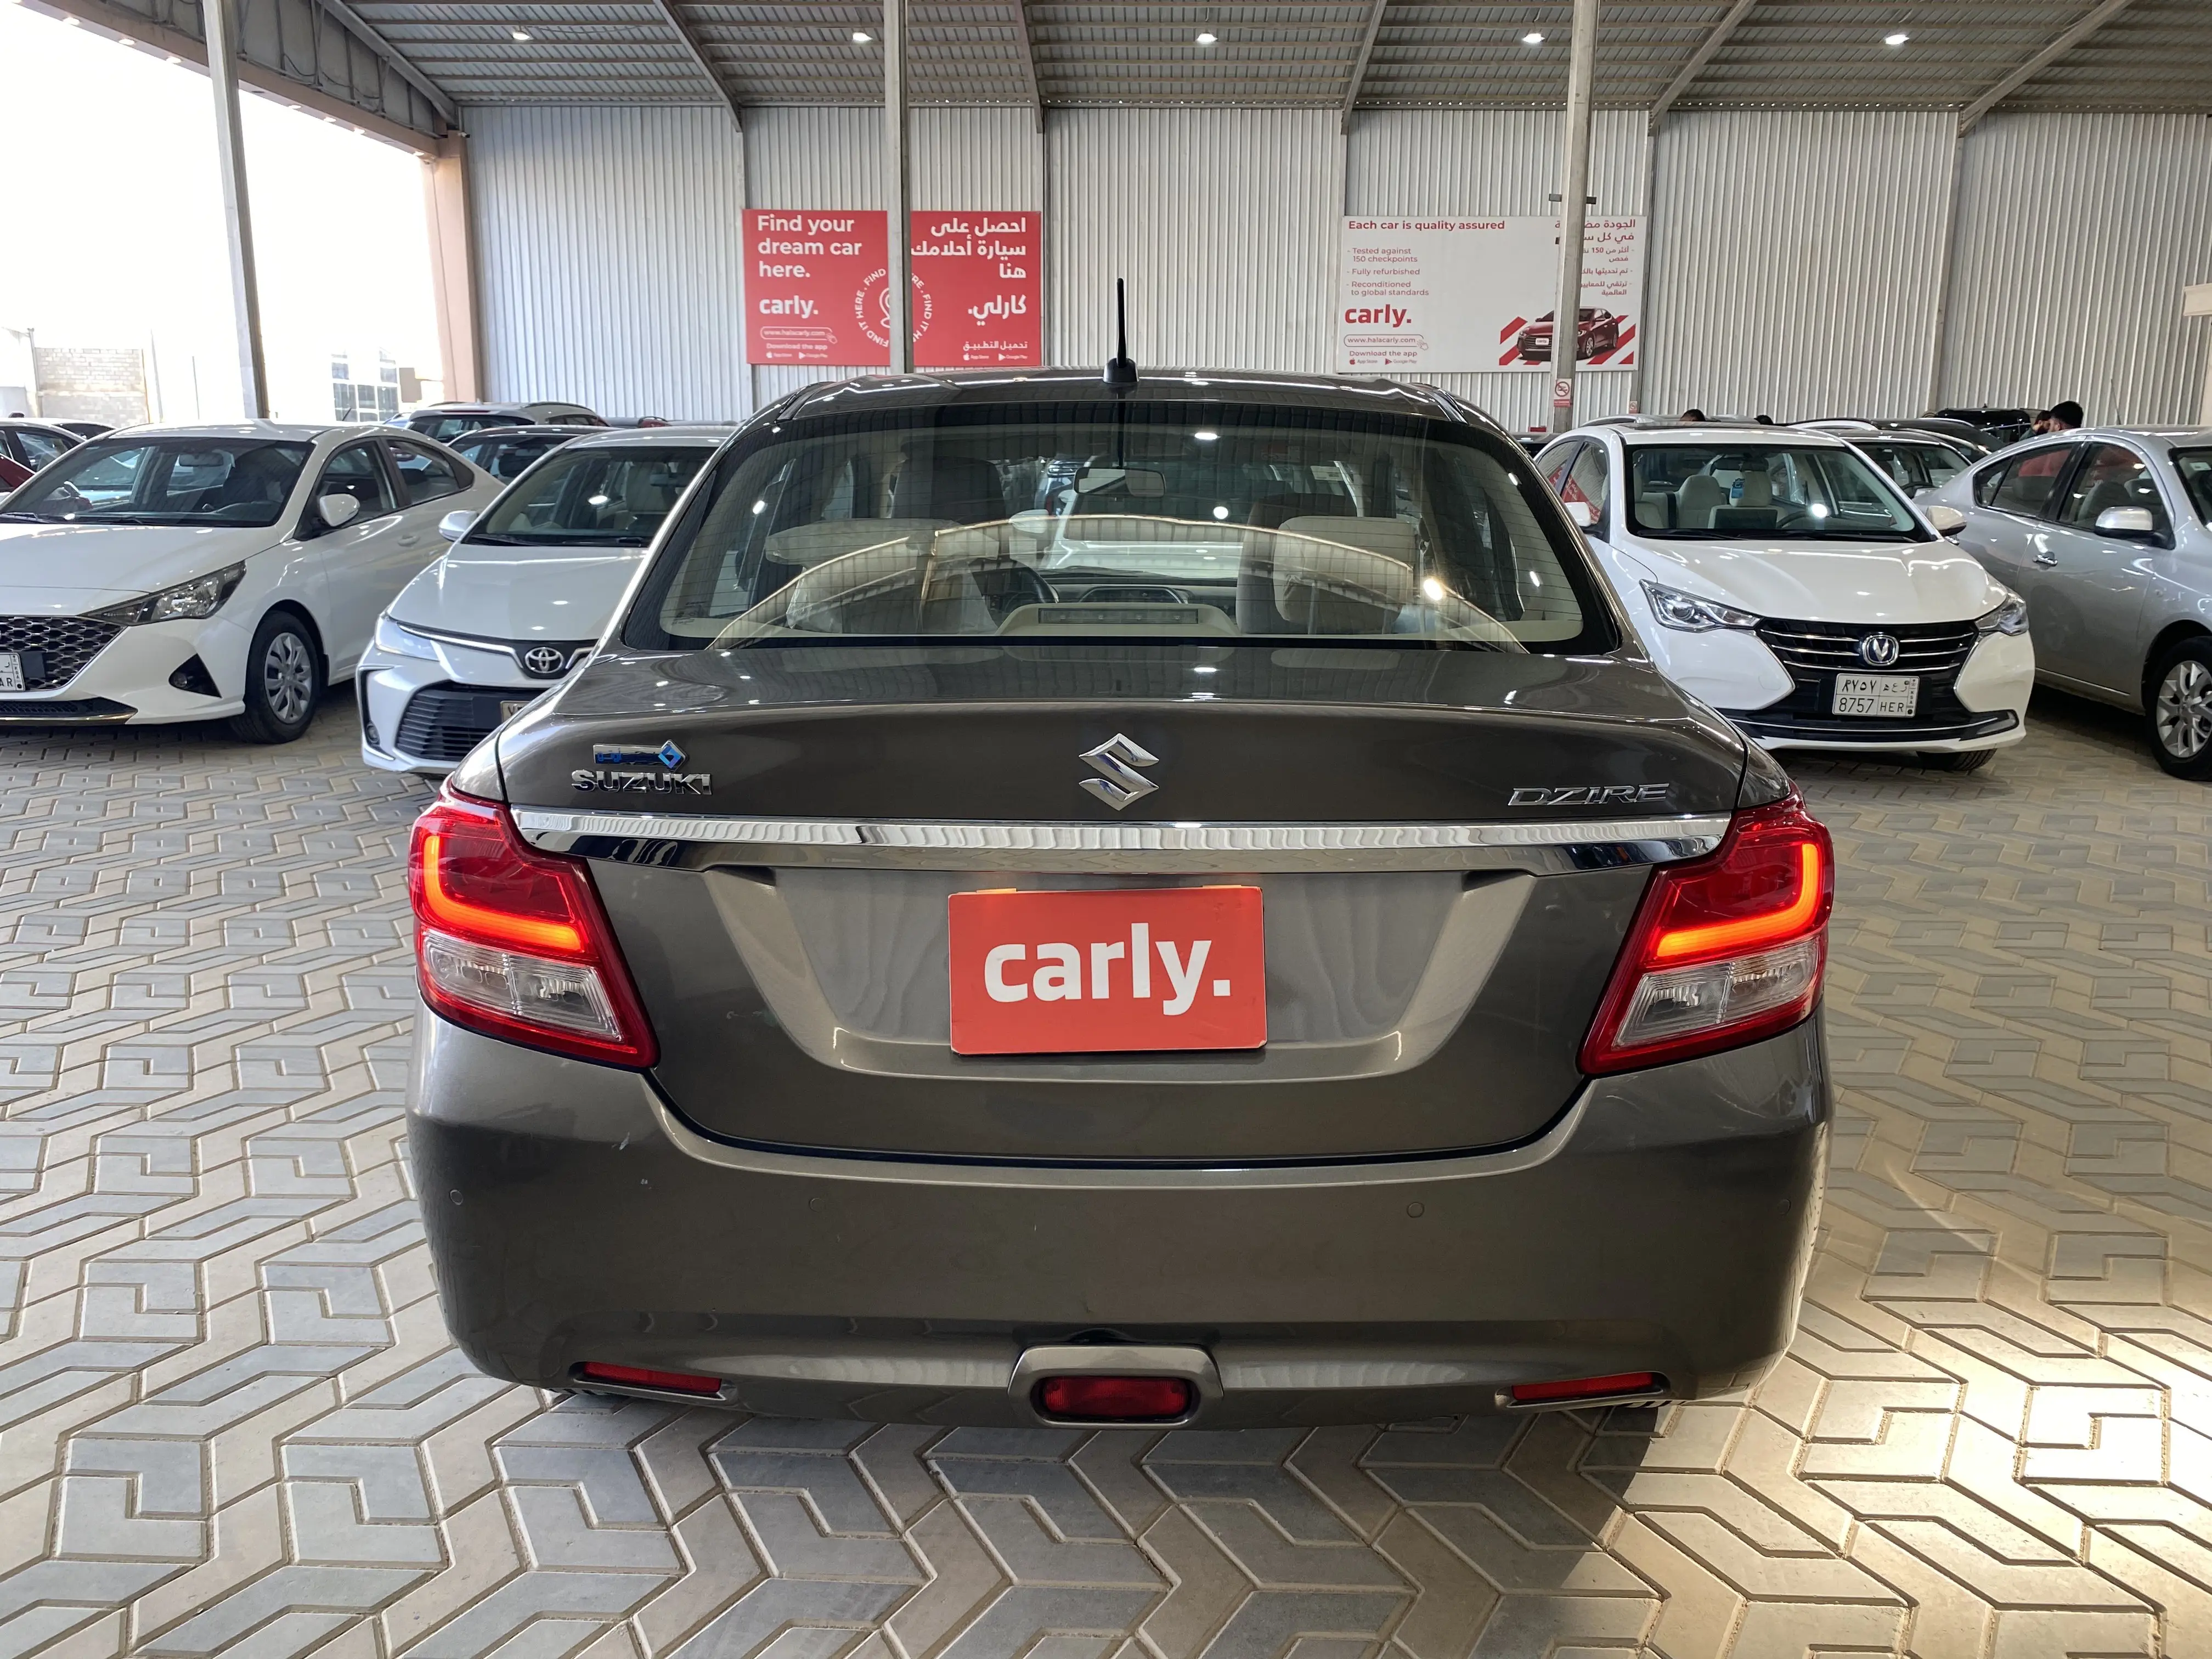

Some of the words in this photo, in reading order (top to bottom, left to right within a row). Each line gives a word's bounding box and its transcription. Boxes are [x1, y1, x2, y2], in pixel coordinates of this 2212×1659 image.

[758, 213, 802, 232] Find
[808, 219, 855, 236] your
[930, 217, 969, 237] على
[974, 217, 1026, 237] احصل
[1348, 221, 1377, 229] Each
[1402, 220, 1412, 229] is
[1415, 220, 1456, 231] quality
[1459, 221, 1505, 229] assured
[1604, 219, 1636, 230] الجودة
[758, 237, 824, 255] dream
[830, 242, 862, 255] car
[911, 234, 972, 256] أحلامك
[1598, 232, 1611, 242] كل
[1615, 232, 1634, 244] في
[977, 240, 1026, 260] سيارة
[759, 260, 811, 278] here.
[863, 268, 887, 286] FIND
[999, 263, 1026, 278] هنا
[759, 295, 819, 319] carly.
[855, 290, 865, 319] HERE
[922, 294, 933, 319] FIND
[858, 321, 869, 330] IT
[1345, 304, 1412, 328] carly.
[919, 320, 929, 332] IT
[866, 330, 889, 347] FIND
[1838, 697, 1874, 713] 8757
[1880, 701, 1904, 712] HER
[571, 769, 712, 795] SUZUKI
[1508, 783, 1670, 806] DZIRE
[984, 922, 1231, 1016] carly.
